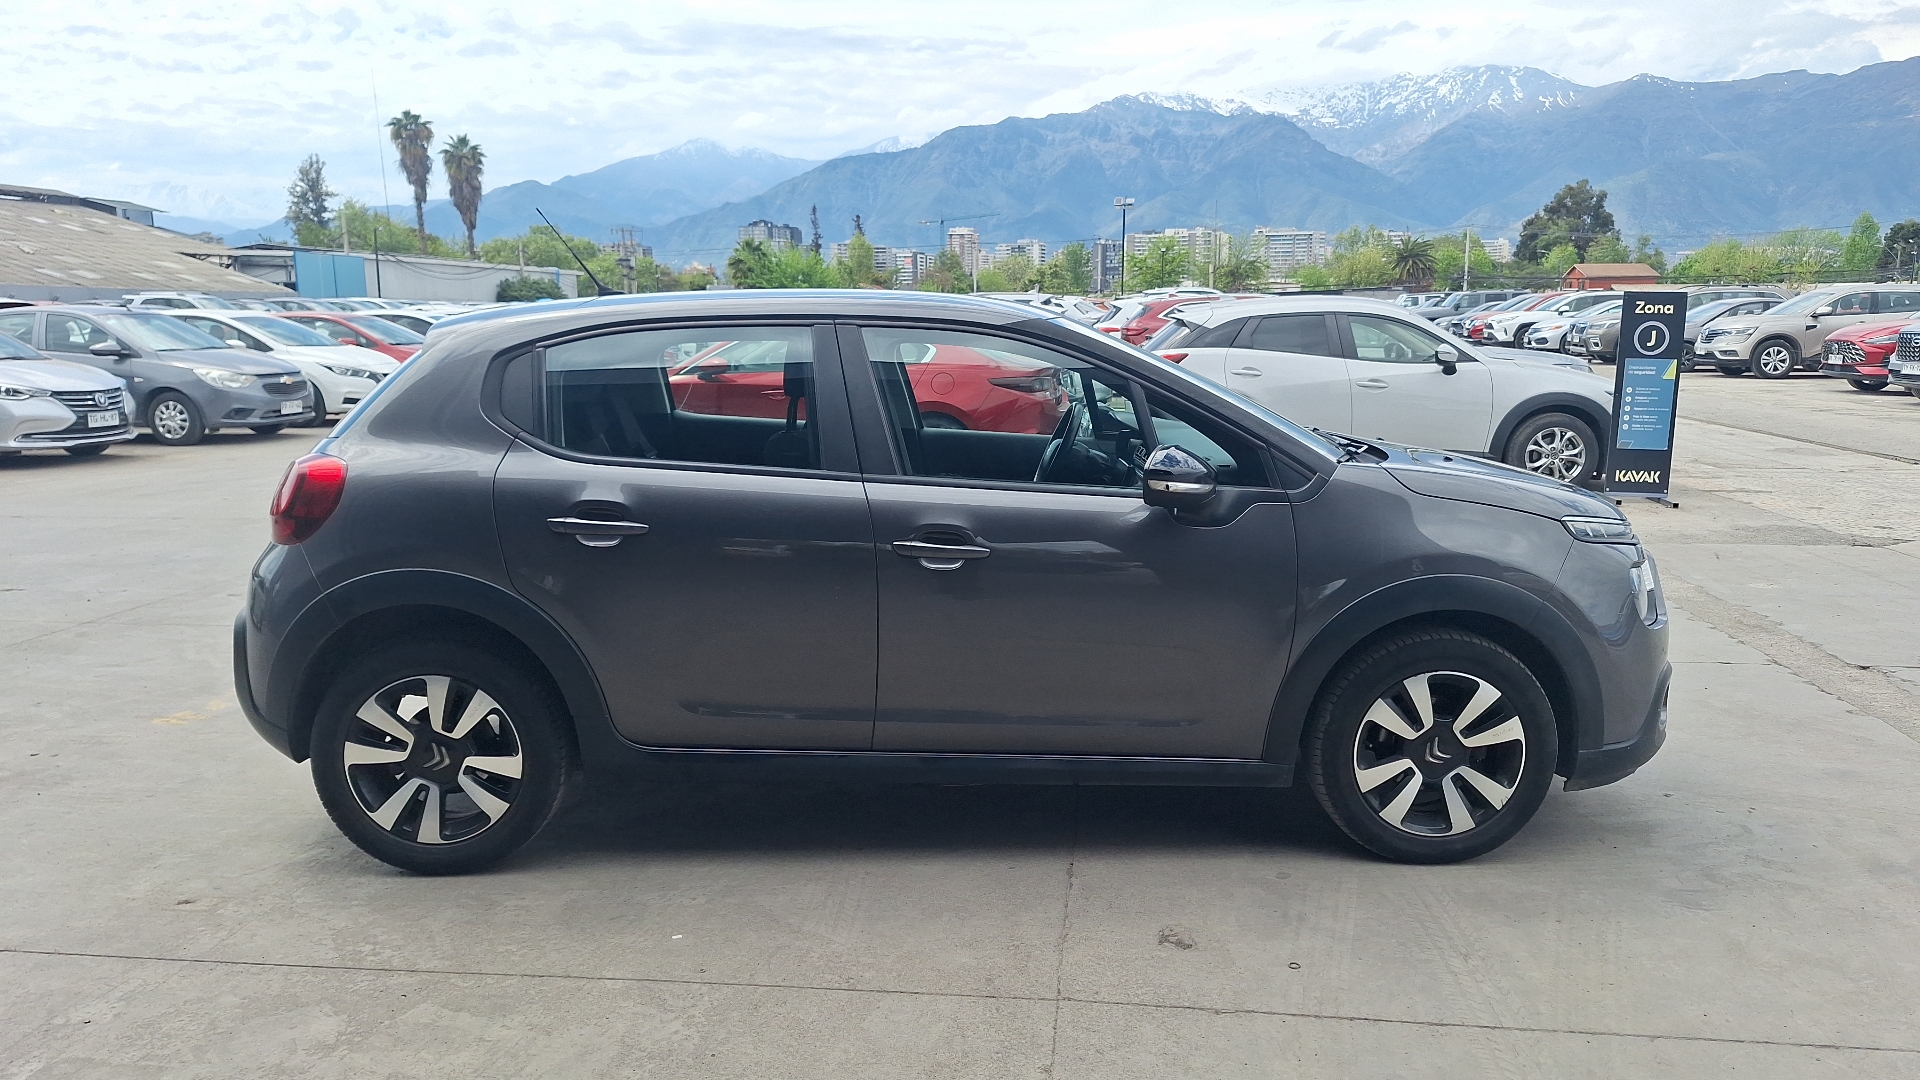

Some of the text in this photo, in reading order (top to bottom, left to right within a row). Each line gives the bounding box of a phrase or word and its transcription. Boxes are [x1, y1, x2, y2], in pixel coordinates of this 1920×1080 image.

[1634, 301, 1674, 314] Zona
[1646, 330, 1657, 346] J
[1615, 470, 1660, 483] KAVAK
